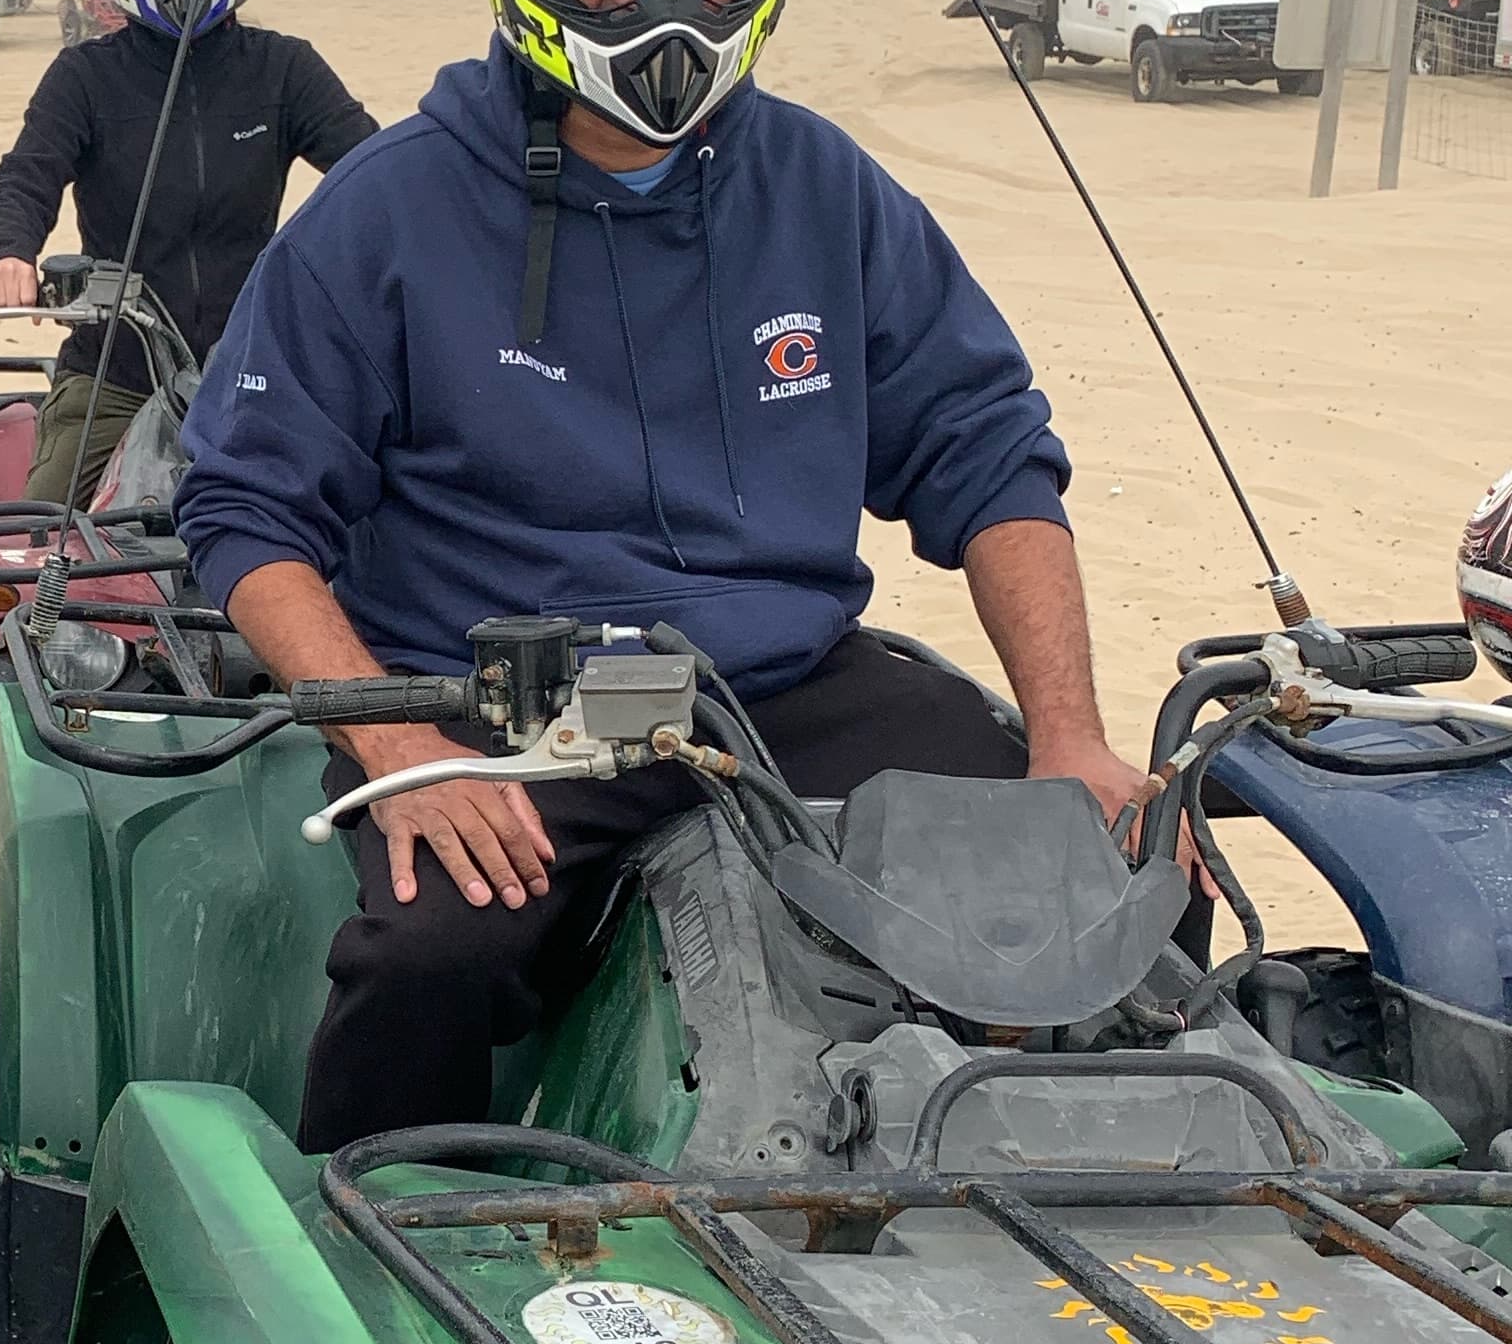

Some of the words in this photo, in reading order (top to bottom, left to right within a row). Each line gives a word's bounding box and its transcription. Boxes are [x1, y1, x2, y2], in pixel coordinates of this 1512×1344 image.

[753, 312, 823, 346] CHAMINADE
[764, 332, 818, 379] C
[758, 373, 832, 402] LACROSSE
[672, 893, 717, 988] YAMAHA
[566, 1288, 635, 1307] QL
